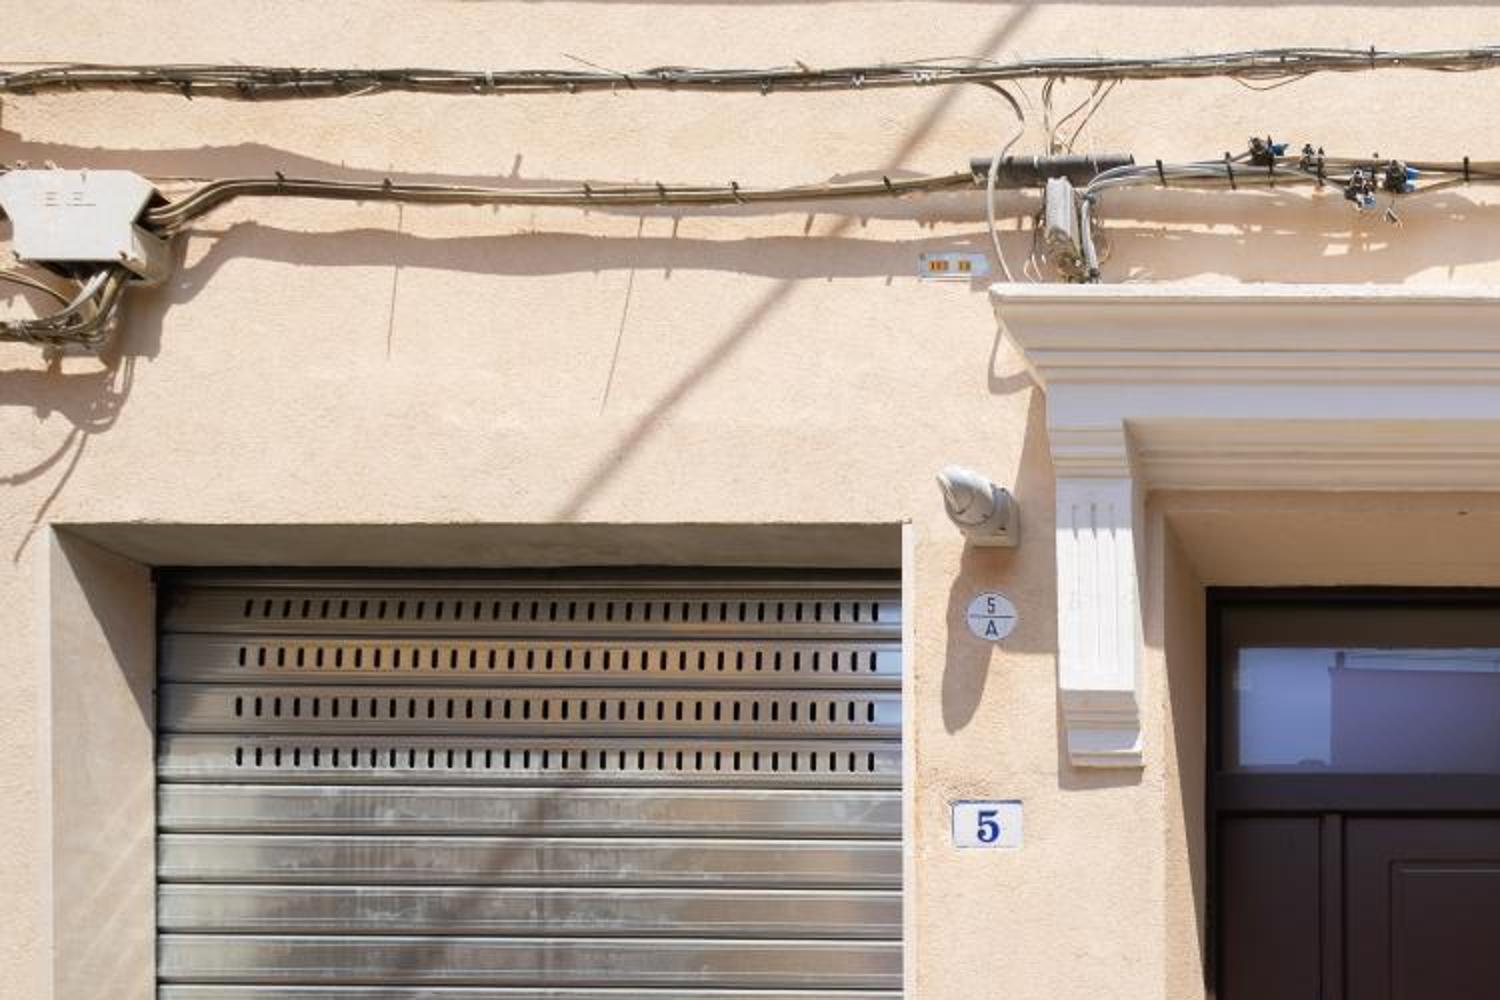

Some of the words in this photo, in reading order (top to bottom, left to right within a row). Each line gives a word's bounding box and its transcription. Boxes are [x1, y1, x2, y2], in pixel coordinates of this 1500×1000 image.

[987, 597, 995, 614] 5
[985, 619, 999, 636] A
[977, 810, 999, 843] 5
